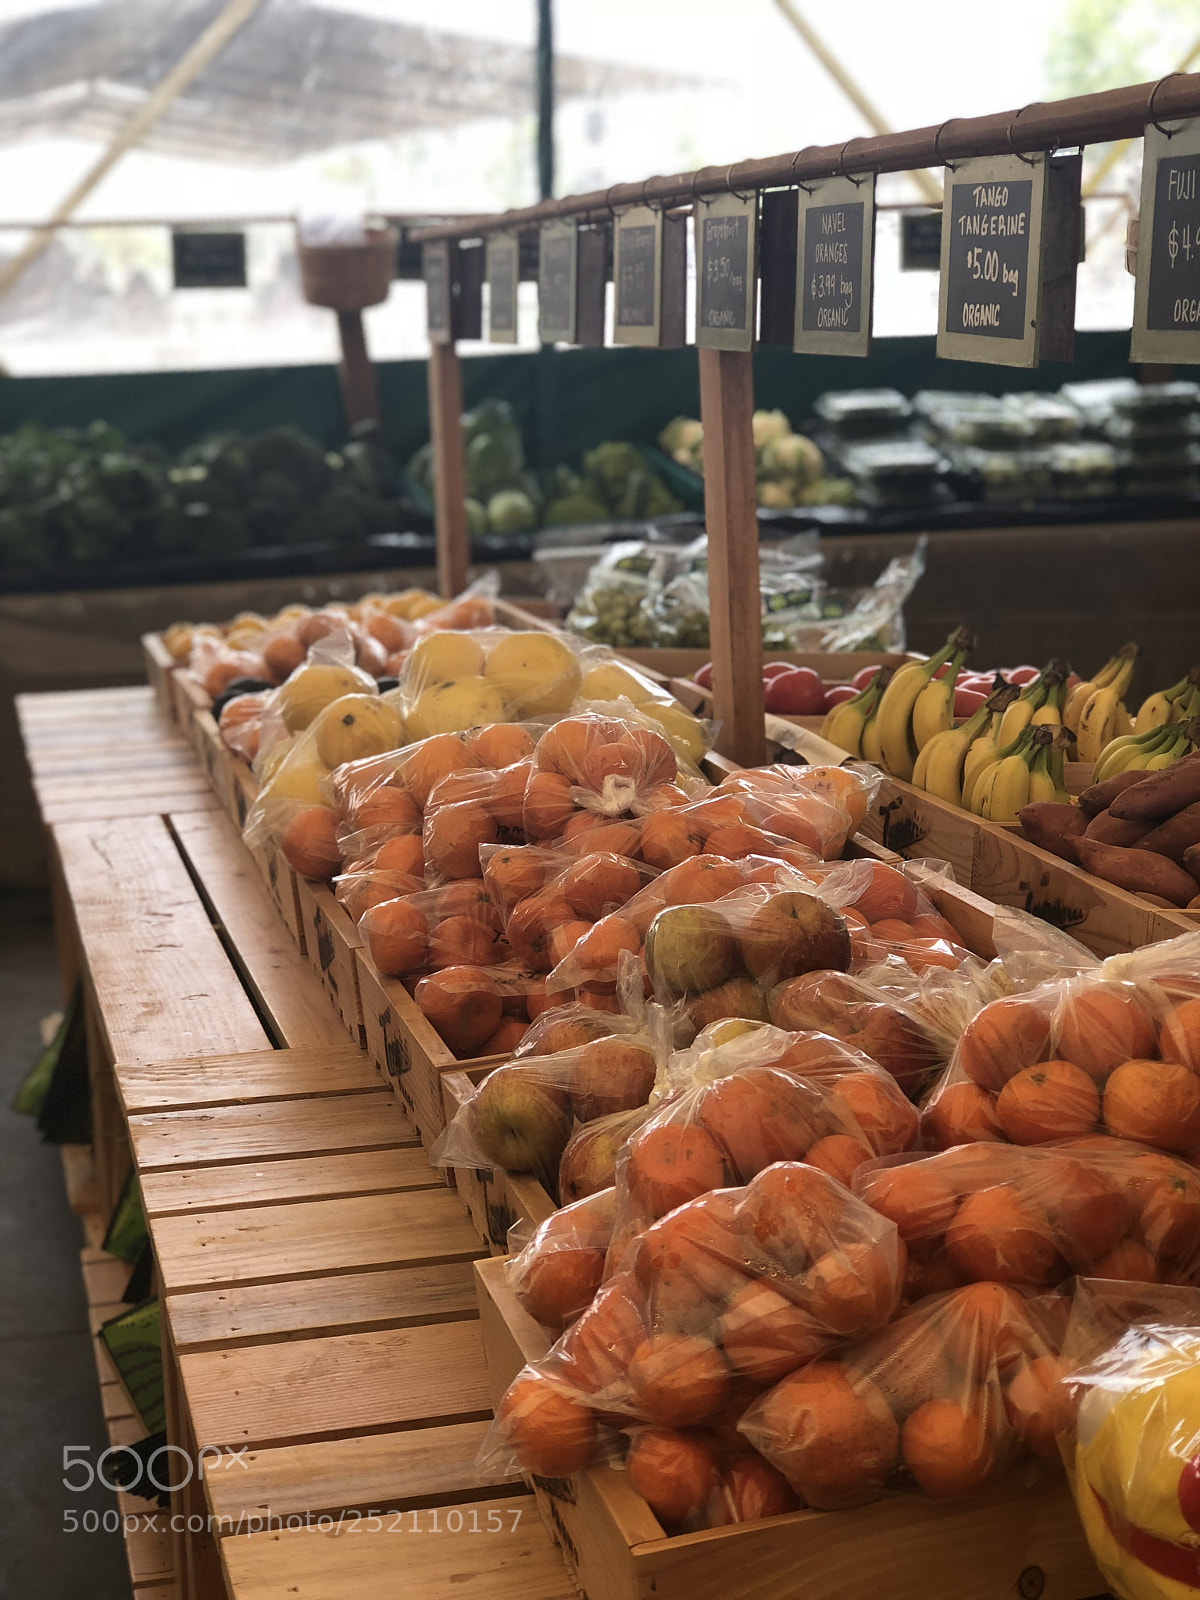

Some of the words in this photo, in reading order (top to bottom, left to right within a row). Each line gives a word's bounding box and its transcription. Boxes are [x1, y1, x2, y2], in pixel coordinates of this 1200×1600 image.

[973, 185, 1009, 208] TANGO
[1168, 169, 1196, 201] FUJI
[822, 211, 846, 234] NAVEL
[958, 212, 1026, 237] TANGERINE
[815, 243, 848, 265] ORANGES
[967, 247, 999, 283] $5.00
[1002, 263, 1019, 297] bag
[840, 275, 853, 308] bag
[817, 306, 849, 328] ORGANIC
[962, 302, 1001, 328] ORGANIC
